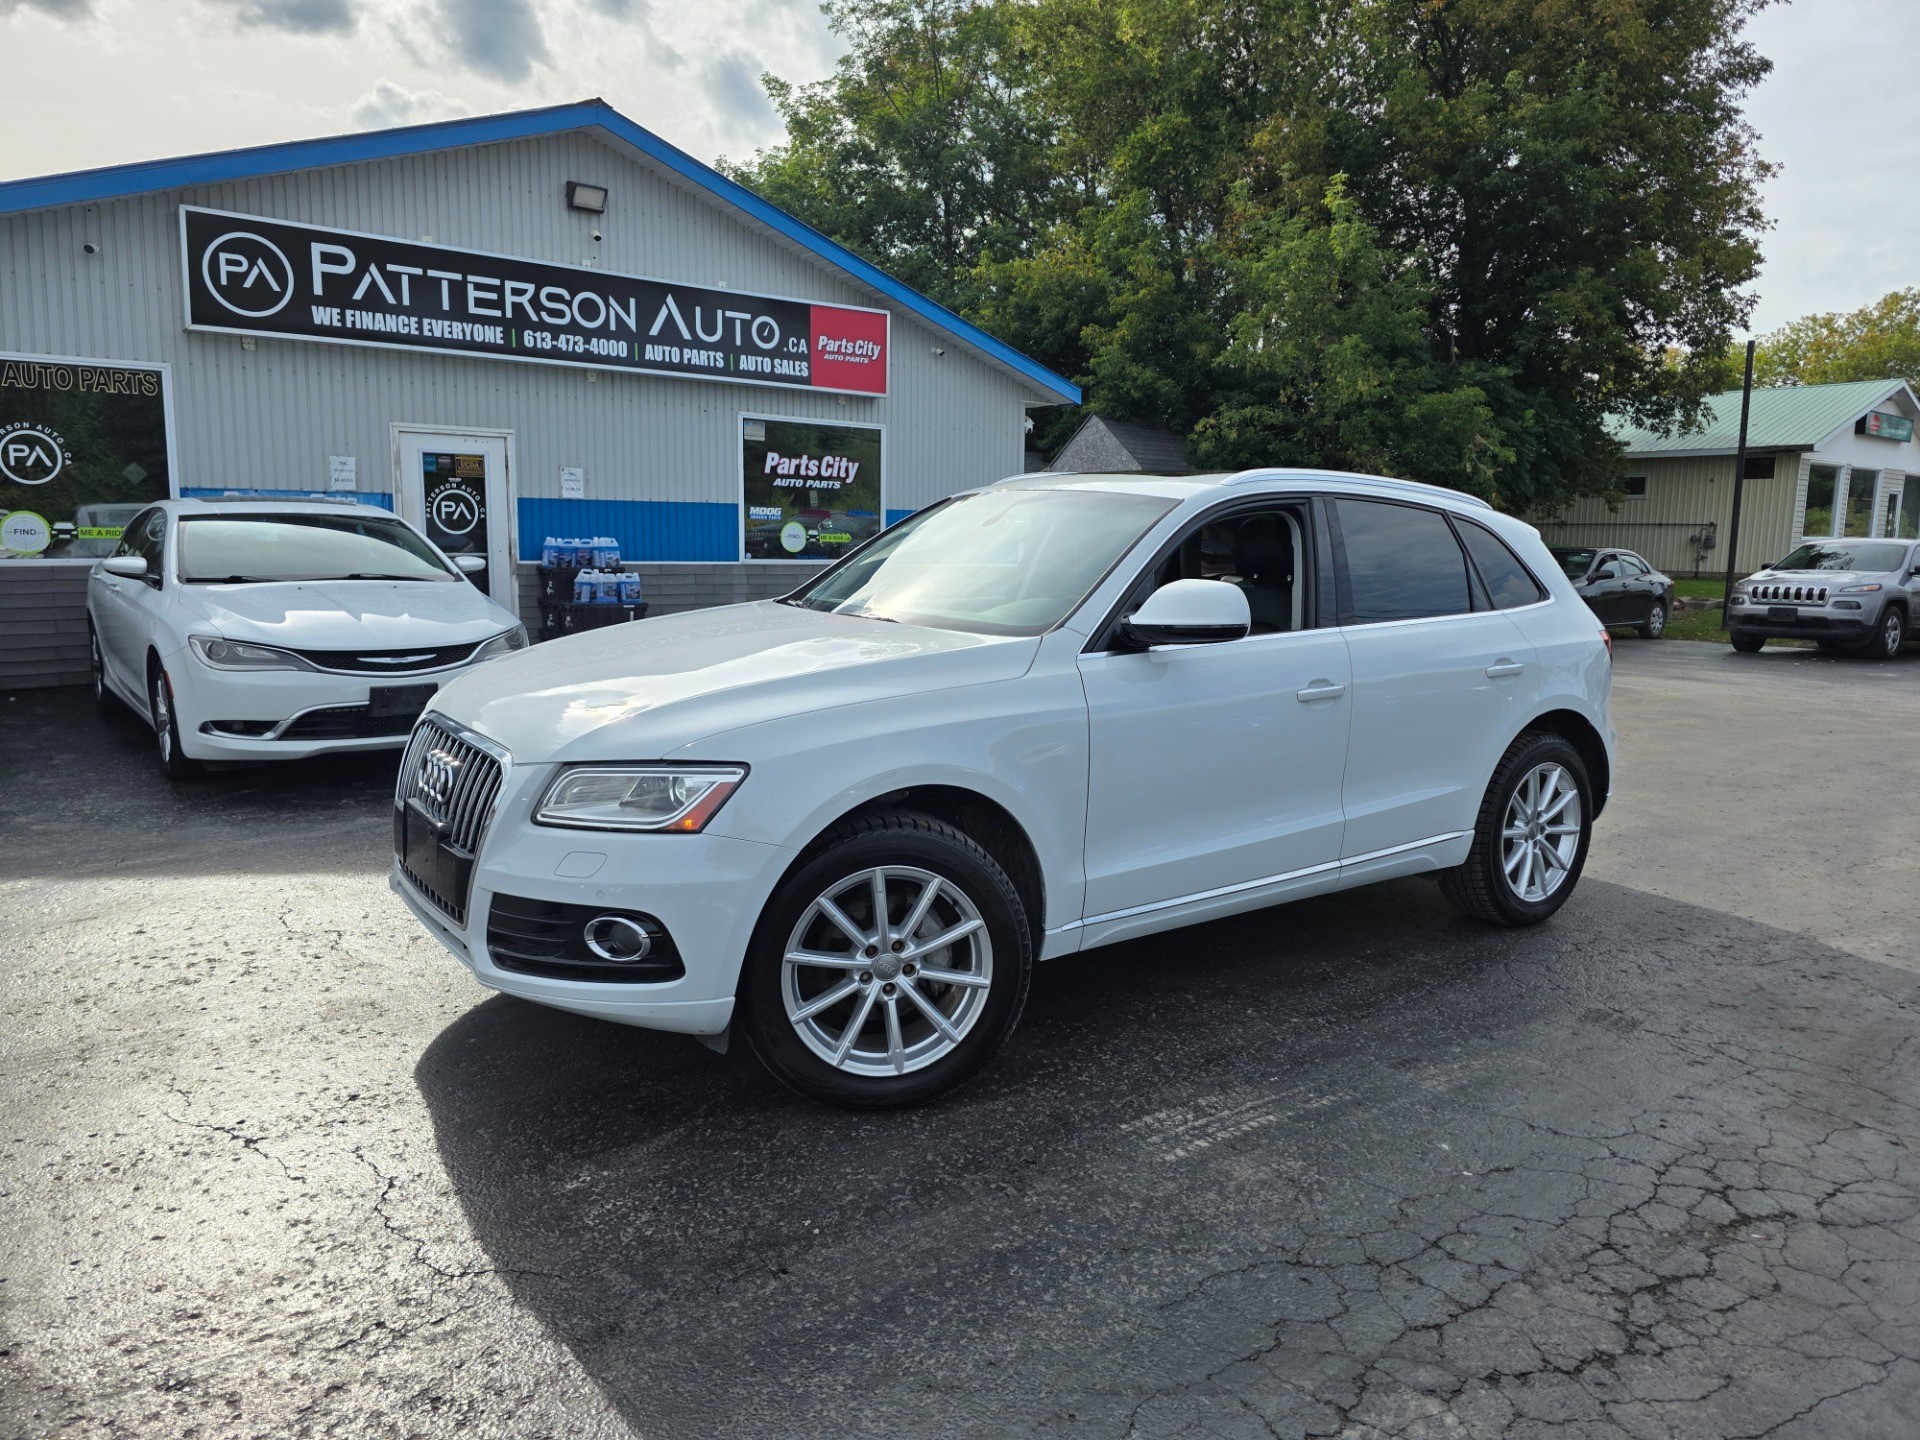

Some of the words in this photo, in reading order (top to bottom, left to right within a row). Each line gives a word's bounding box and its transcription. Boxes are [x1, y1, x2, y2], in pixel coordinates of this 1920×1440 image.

[310, 242, 636, 333] PATTERSON
[312, 305, 342, 327] WE
[346, 310, 419, 335] FINANCE
[422, 318, 504, 344] EVERYONE
[523, 329, 628, 358] 613-473-4000
[644, 344, 682, 363] AUTO
[682, 348, 724, 368] PARTS
[739, 354, 772, 374] AUTO
[774, 358, 809, 378] SALES
[844, 356, 870, 364] PARTS
[2, 362, 72, 390] AUTO
[79, 368, 158, 396] PARTS
[426, 482, 457, 518] PATTERSON
[460, 484, 481, 501] AUTO
[773, 478, 804, 488] AUTO
[805, 480, 842, 490] PARTS
[750, 506, 782, 515] MOOG
